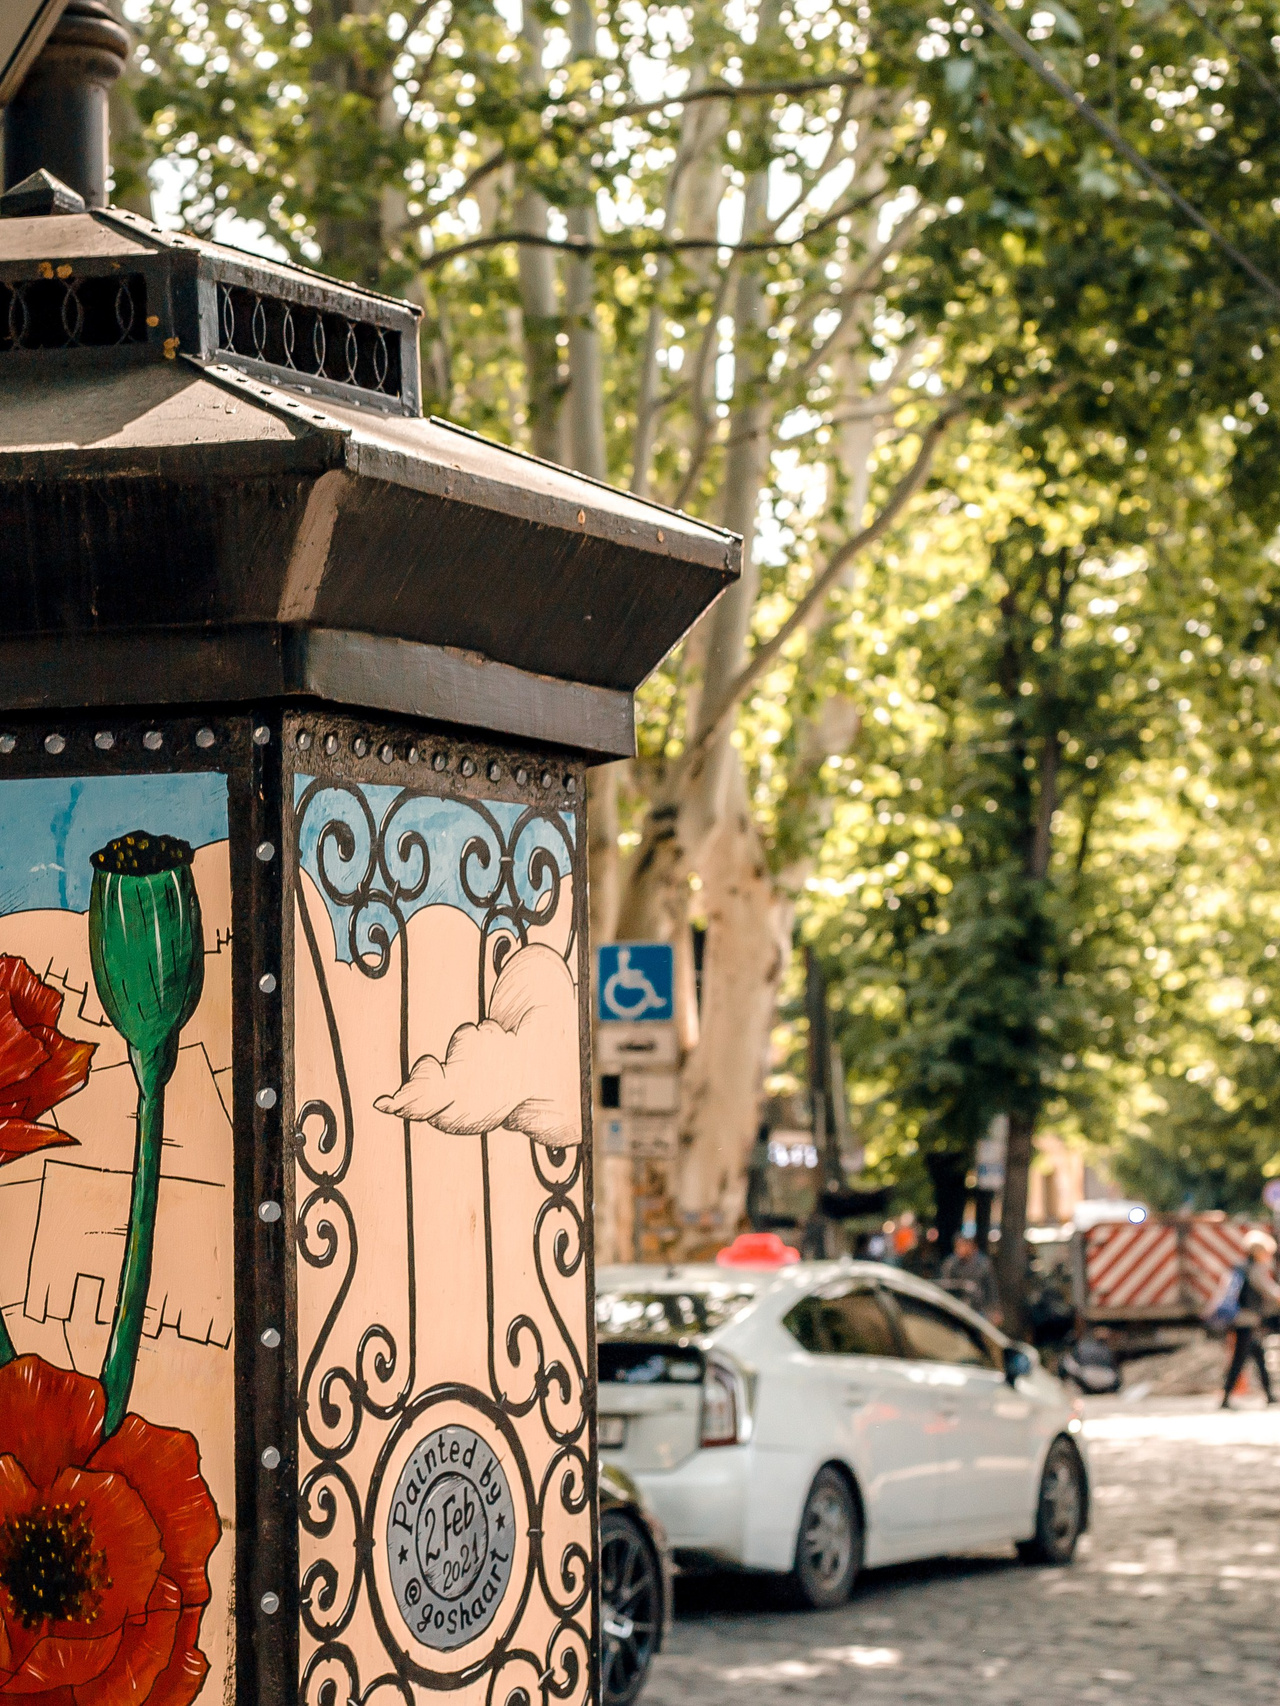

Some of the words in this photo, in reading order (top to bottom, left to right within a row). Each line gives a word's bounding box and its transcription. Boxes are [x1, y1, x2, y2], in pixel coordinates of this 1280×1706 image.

[393, 1434, 477, 1535] Painted
[480, 1457, 502, 1506] by
[424, 1508, 441, 1566] 2
[443, 1487, 476, 1552] Feb
[443, 1532, 480, 1593] 2021
